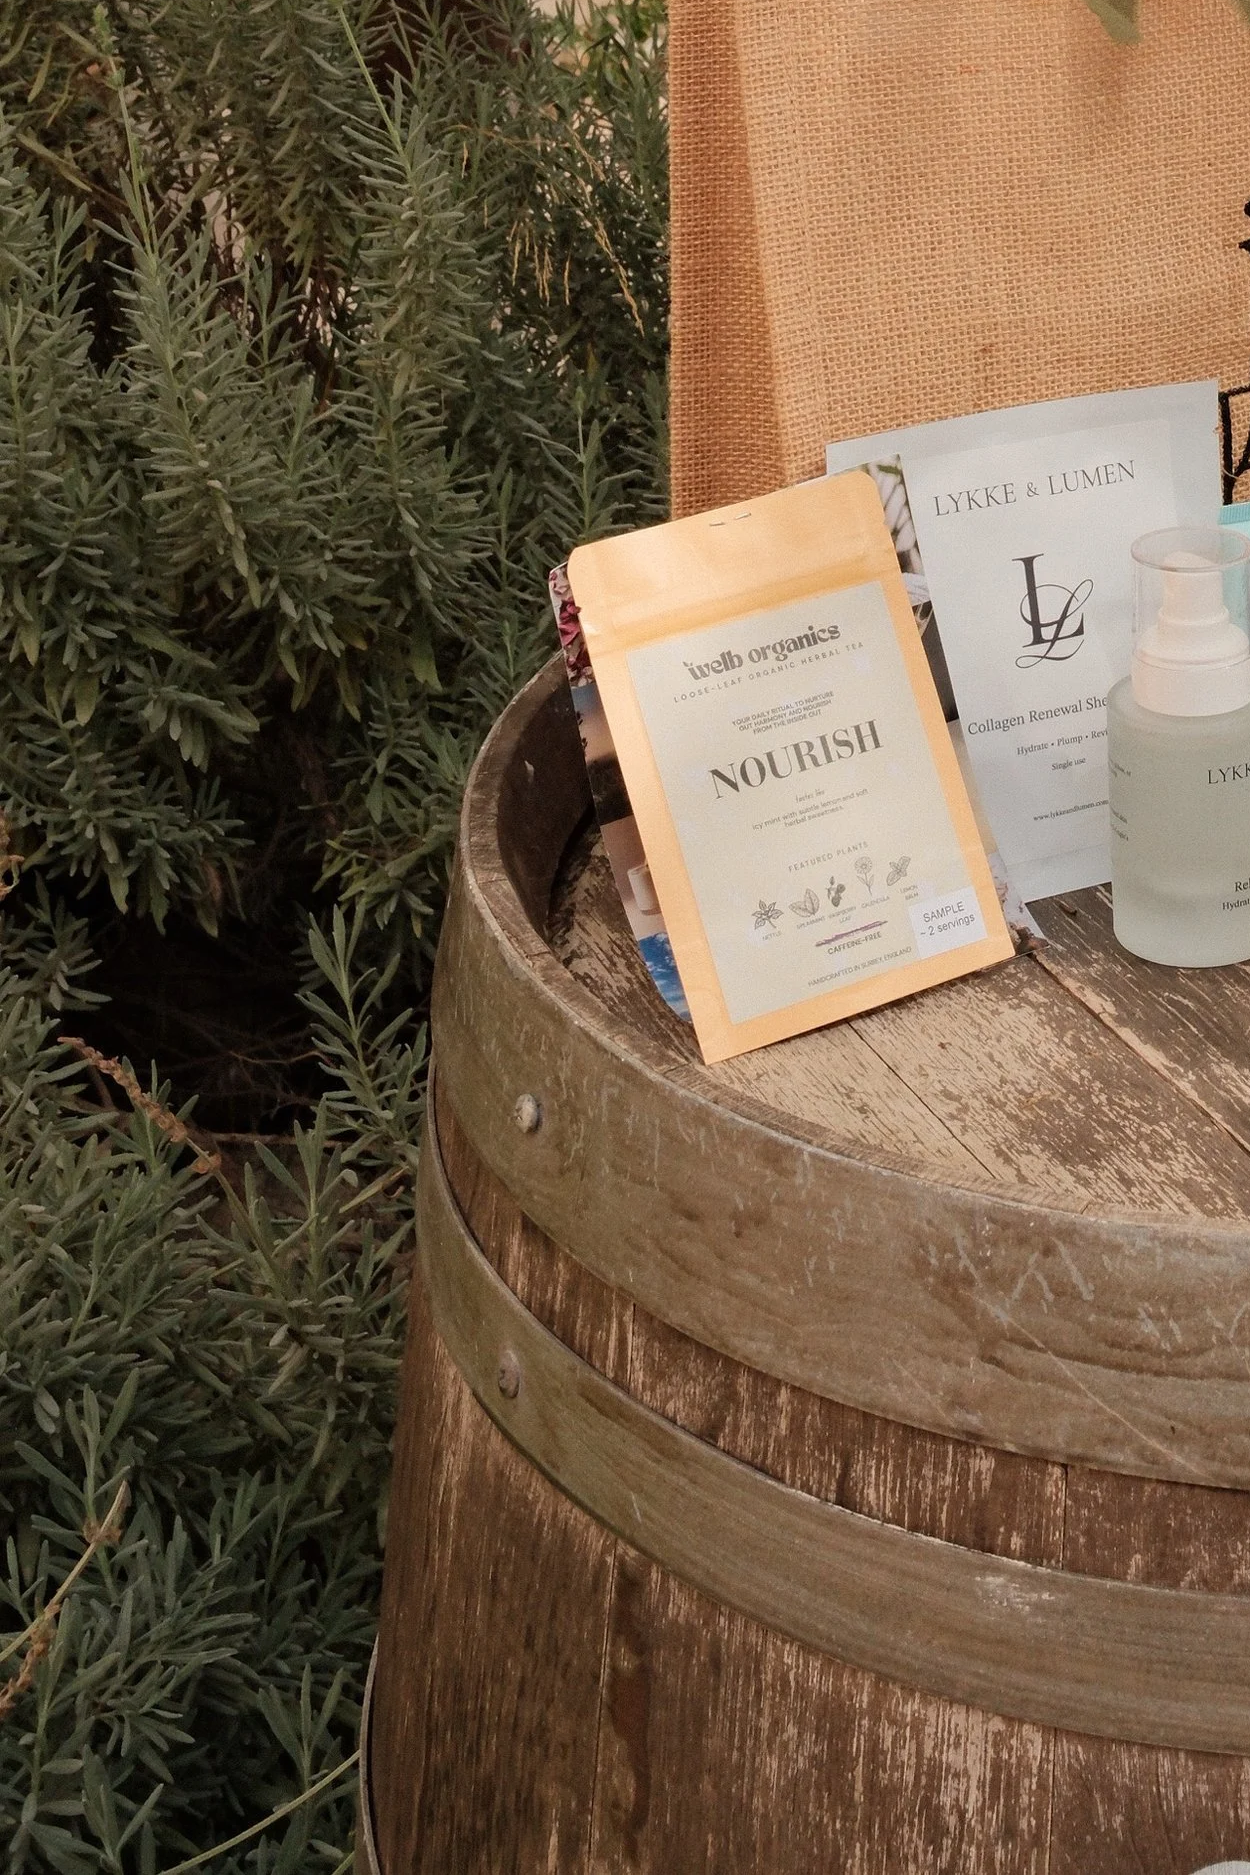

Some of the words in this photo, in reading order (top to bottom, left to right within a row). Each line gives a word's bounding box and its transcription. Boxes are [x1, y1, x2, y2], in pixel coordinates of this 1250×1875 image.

[933, 482, 1018, 517] LYKKE
[1026, 481, 1040, 498] &
[1048, 460, 1136, 496] LUMEN
[748, 624, 841, 663] organics
[673, 676, 743, 704] LOOSE-LEAF
[748, 662, 796, 681] ORGANIC
[801, 649, 841, 666] HERBAL
[846, 641, 865, 653] TEA
[732, 716, 751, 726] YOUR
[752, 710, 770, 721] DAILY
[771, 703, 794, 715] RITUAL
[795, 700, 805, 708] TO
[805, 691, 834, 704] NURTURE
[753, 724, 772, 735] FROM
[773, 720, 785, 729] THE
[808, 709, 822, 718] OUT
[754, 713, 787, 727] HARMONY
[789, 708, 802, 717] AND
[967, 714, 1025, 736] Collagen
[1028, 699, 1083, 723] Renewal
[708, 718, 884, 800] NOURISH
[1016, 742, 1048, 757] Hydrate
[1057, 734, 1083, 747] Plump
[1051, 760, 1073, 771] Single
[1074, 757, 1086, 766] use
[764, 816, 781, 826] mint
[782, 811, 798, 821] with
[820, 797, 841, 807] lemon
[842, 792, 855, 801] and
[784, 816, 807, 828] herbal
[788, 853, 834, 873] FEATURED
[836, 841, 869, 856] PLANTS
[923, 901, 965, 923] SAMPLE
[928, 925, 935, 937] 2
[937, 912, 975, 934] servings
[827, 931, 883, 955] CAFFEINE-FREE
